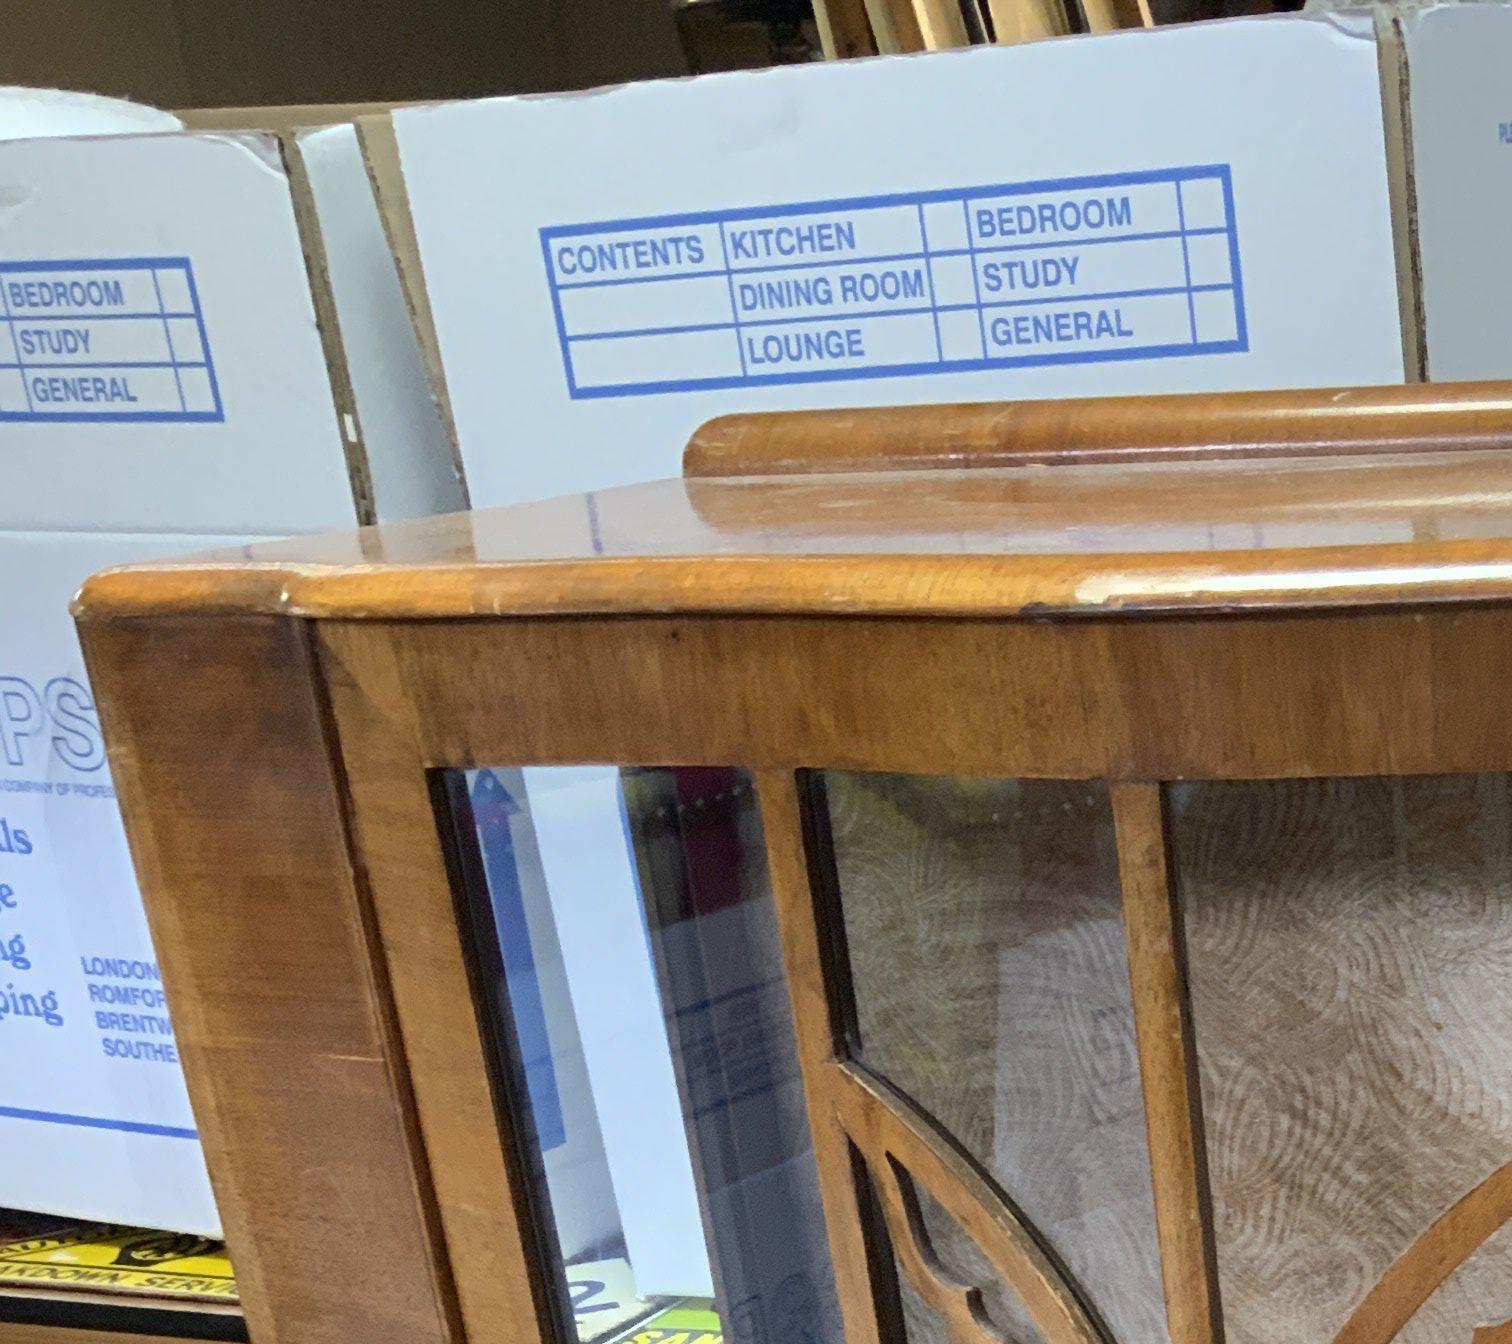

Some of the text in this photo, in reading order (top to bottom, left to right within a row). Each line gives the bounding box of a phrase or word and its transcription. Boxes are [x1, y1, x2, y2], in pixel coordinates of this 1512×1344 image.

[557, 197, 1133, 276] CONTENTS KITCHEN BEDROOM
[8, 280, 125, 308] BEDROOM
[739, 255, 1079, 313] DINING ROOM STUDY
[19, 329, 90, 355] STUDY
[748, 308, 1134, 366] LOUNGE GENERAL
[31, 377, 139, 402] GENERAL
